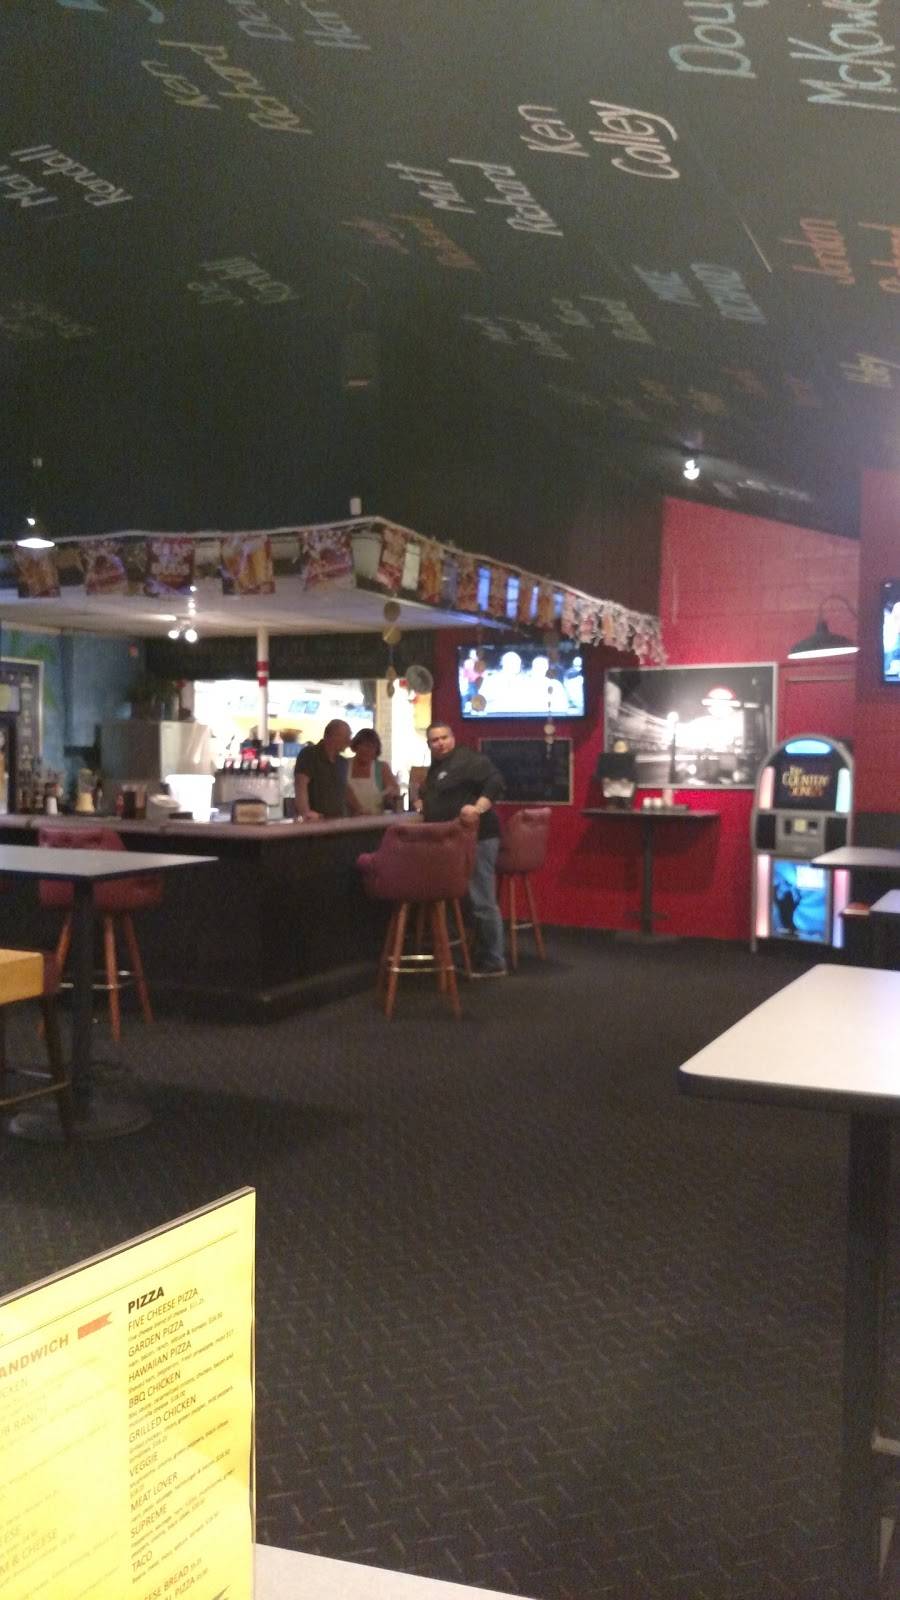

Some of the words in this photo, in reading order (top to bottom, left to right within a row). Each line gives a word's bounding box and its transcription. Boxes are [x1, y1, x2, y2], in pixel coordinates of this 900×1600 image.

[516, 103, 591, 159] Ken
[588, 99, 681, 181] Colley
[9, 143, 134, 208] Randall
[385, 160, 478, 215] Matt
[447, 156, 566, 237] Richard
[128, 1287, 164, 1314] PIZZA
[128, 1315, 145, 1332] FIVE
[147, 1299, 176, 1320] CHEESE
[177, 1288, 199, 1305] PIZZA
[128, 1332, 161, 1357] GARDEN
[163, 1320, 184, 1336] PIZZA
[128, 1352, 168, 1382] HAWAIIAN
[170, 1340, 192, 1358] PIZZA
[128, 1391, 146, 1409] BBQ
[147, 1369, 181, 1397] CHICKEN
[129, 1416, 162, 1443] GRILLED
[163, 1394, 197, 1422] CHICKEN
[130, 1451, 158, 1477] VEGGIE
[131, 1489, 151, 1513] MEAT
[153, 1471, 178, 1496] LOVER
[130, 1503, 167, 1539] SUPREME
[132, 1550, 153, 1573] TACO
[163, 1565, 189, 1592] BREAD
